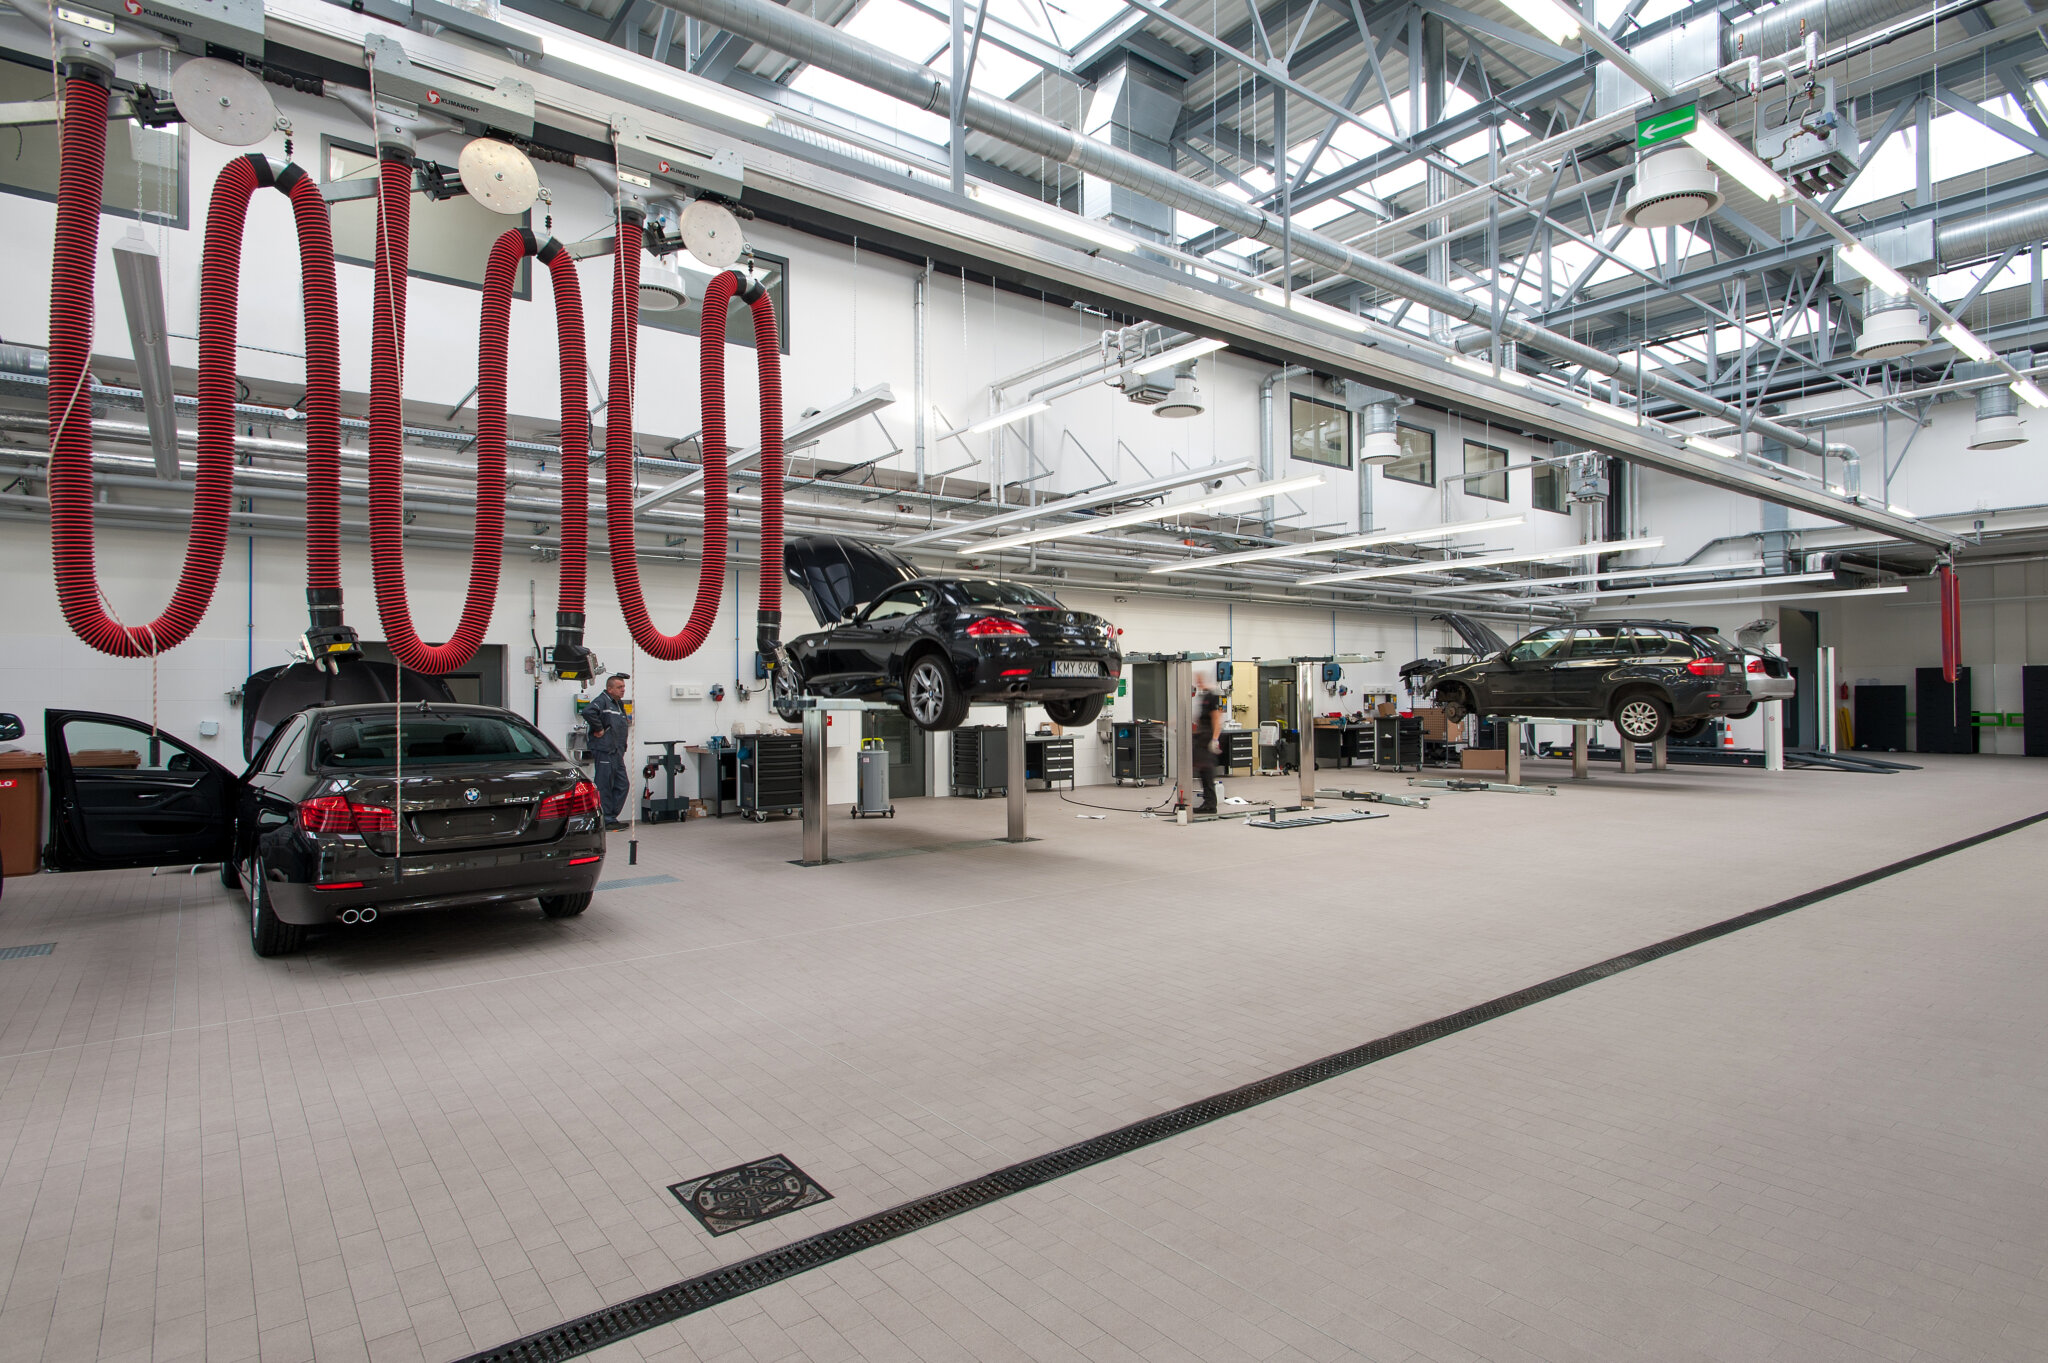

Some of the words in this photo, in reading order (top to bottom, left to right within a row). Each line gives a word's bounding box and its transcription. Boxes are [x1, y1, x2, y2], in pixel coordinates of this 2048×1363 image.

[143, 8, 194, 28] KLIMAWENT
[440, 97, 480, 113] KLIMAWENT
[669, 167, 700, 180] KLIMAWENT
[1056, 662, 1076, 674] KMY
[1078, 662, 1098, 674] 96K6
